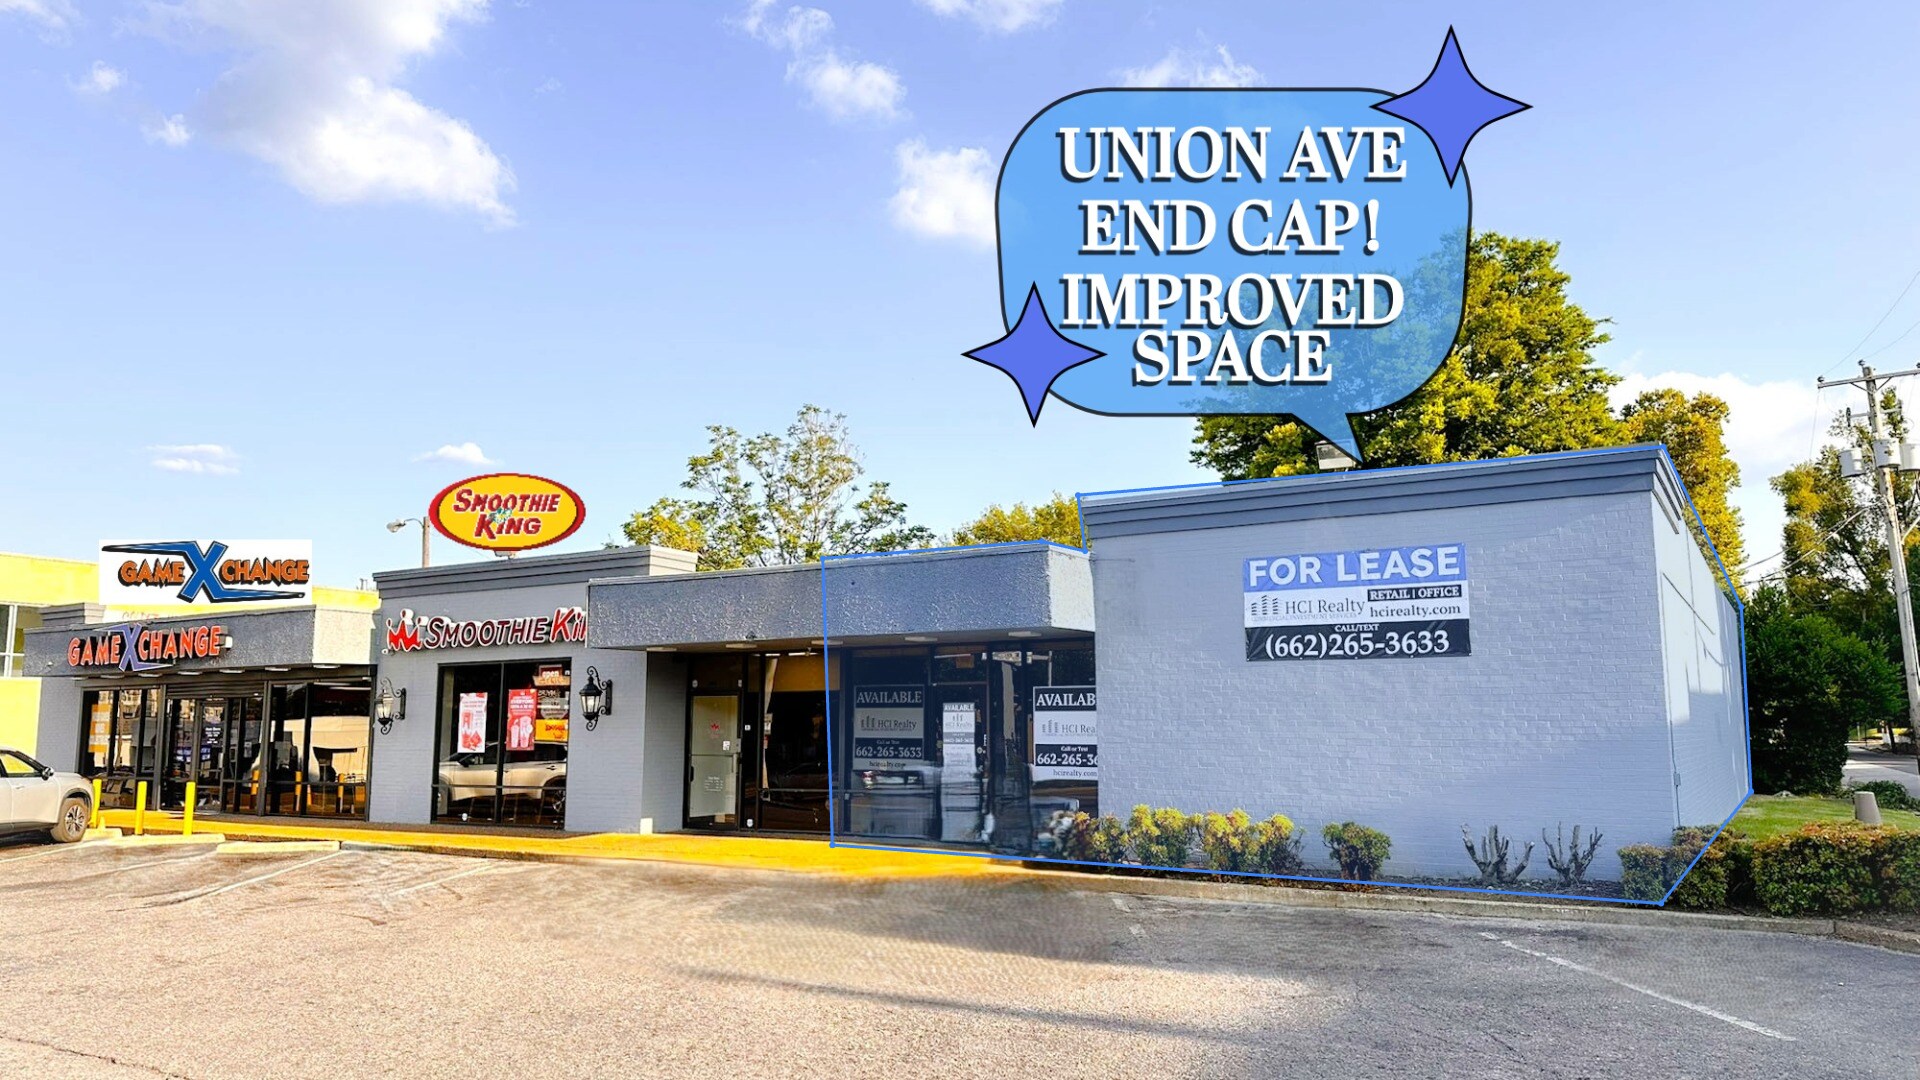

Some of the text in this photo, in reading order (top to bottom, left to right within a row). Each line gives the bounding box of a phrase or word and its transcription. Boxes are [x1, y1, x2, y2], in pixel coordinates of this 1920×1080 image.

[1249, 546, 1461, 588] FOR LEASE
[1369, 585, 1461, 600] RETAIL OFFICE
[1285, 597, 1366, 616] HCI Realty
[1369, 604, 1462, 618] hcirealty.com
[424, 616, 549, 649] SMOOTHIE
[1335, 623, 1380, 632] CALL/TEXT
[1264, 629, 1451, 660] (662)265-3633
[856, 691, 922, 704] AVAILABLE
[1036, 692, 1096, 706] AVAILAB
[944, 703, 975, 711] AVAILABLE
[877, 719, 917, 730] HCI Realty
[1061, 724, 1078, 733] HCI
[856, 746, 922, 758] 662-265-3633
